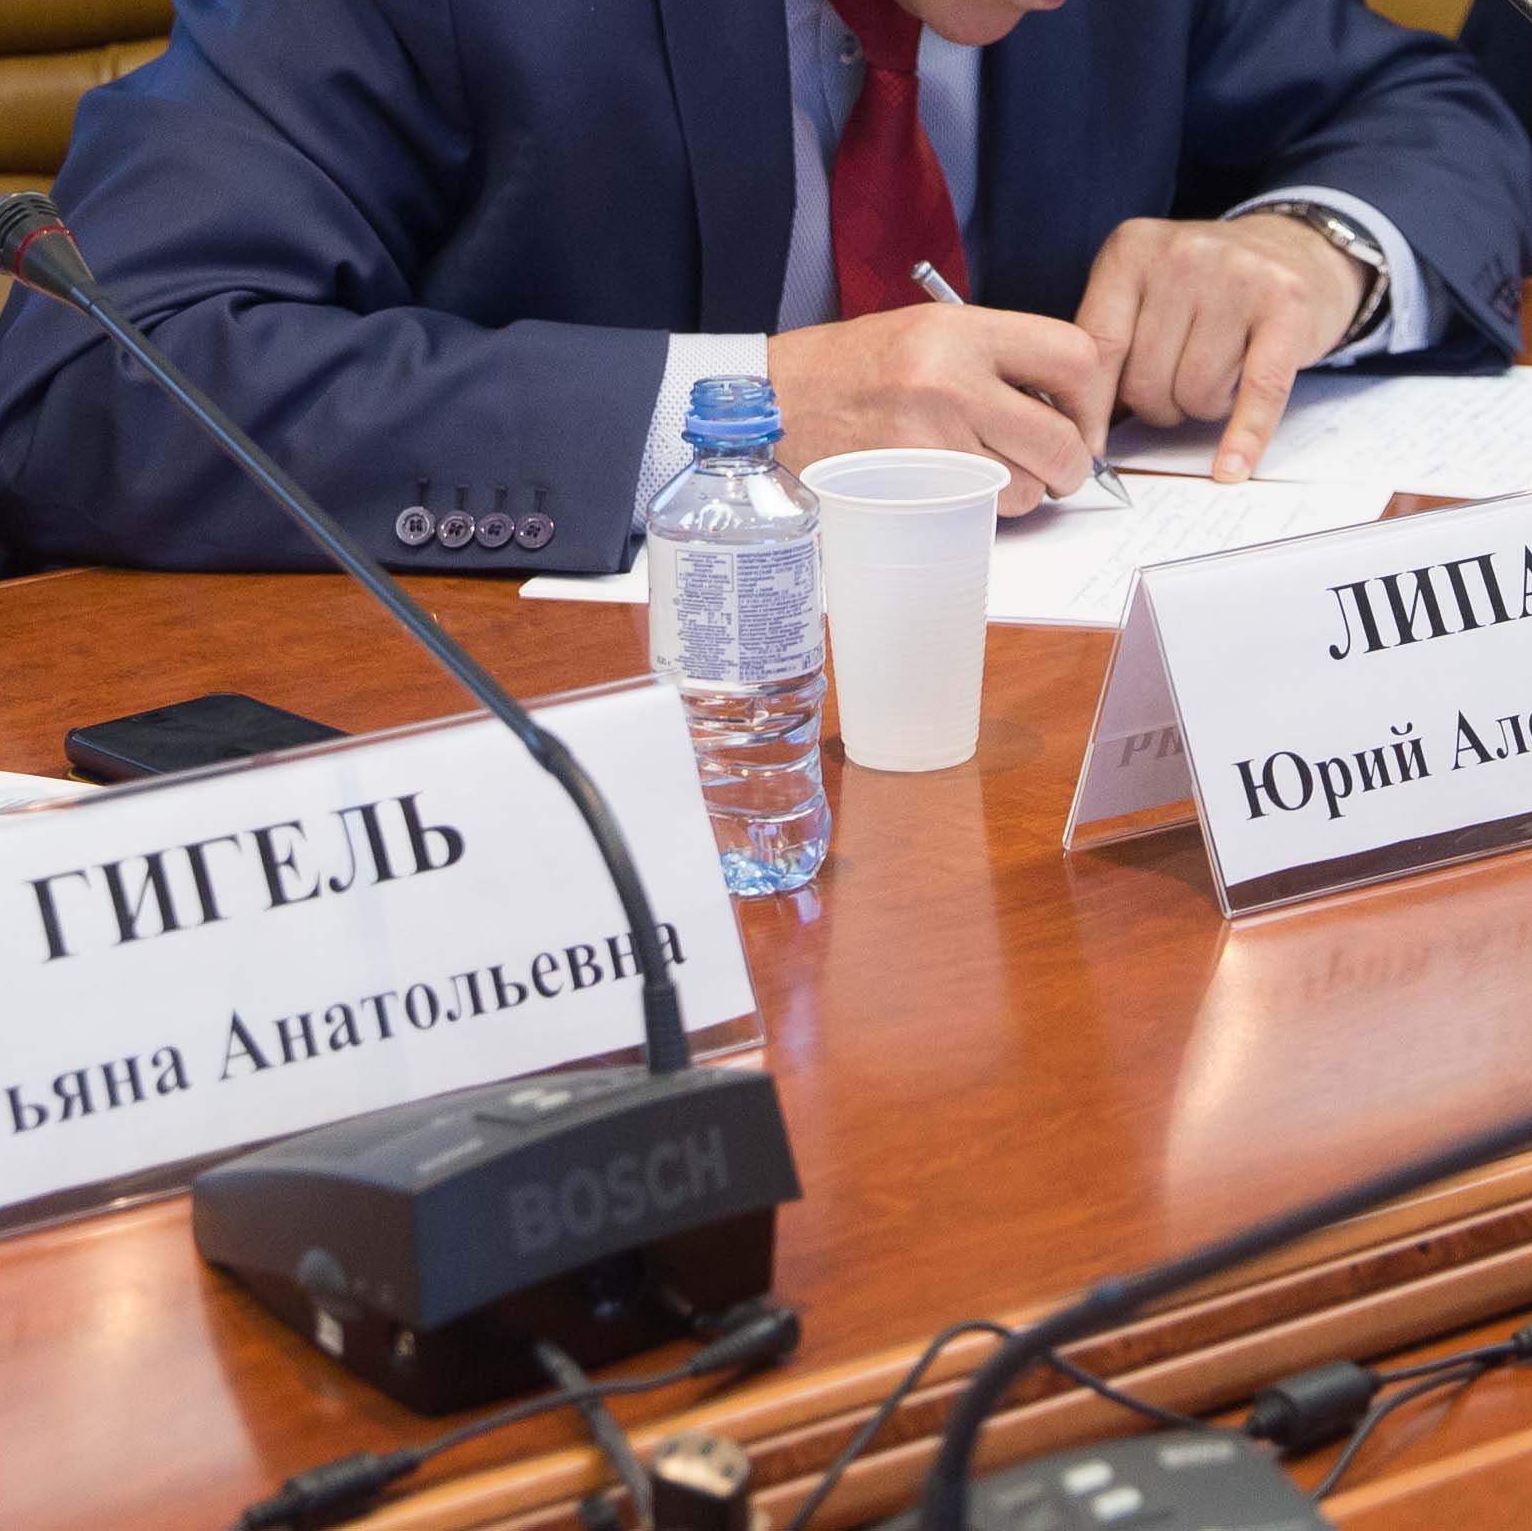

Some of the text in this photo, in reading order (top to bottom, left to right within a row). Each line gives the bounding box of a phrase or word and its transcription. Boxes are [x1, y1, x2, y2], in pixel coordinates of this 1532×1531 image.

[1232, 722, 1431, 820] Юрий
[25, 791, 467, 963] ГИГЕЛЬ
[218, 921, 687, 1080] Анатольевна
[511, 1124, 728, 1254] BOSCH
